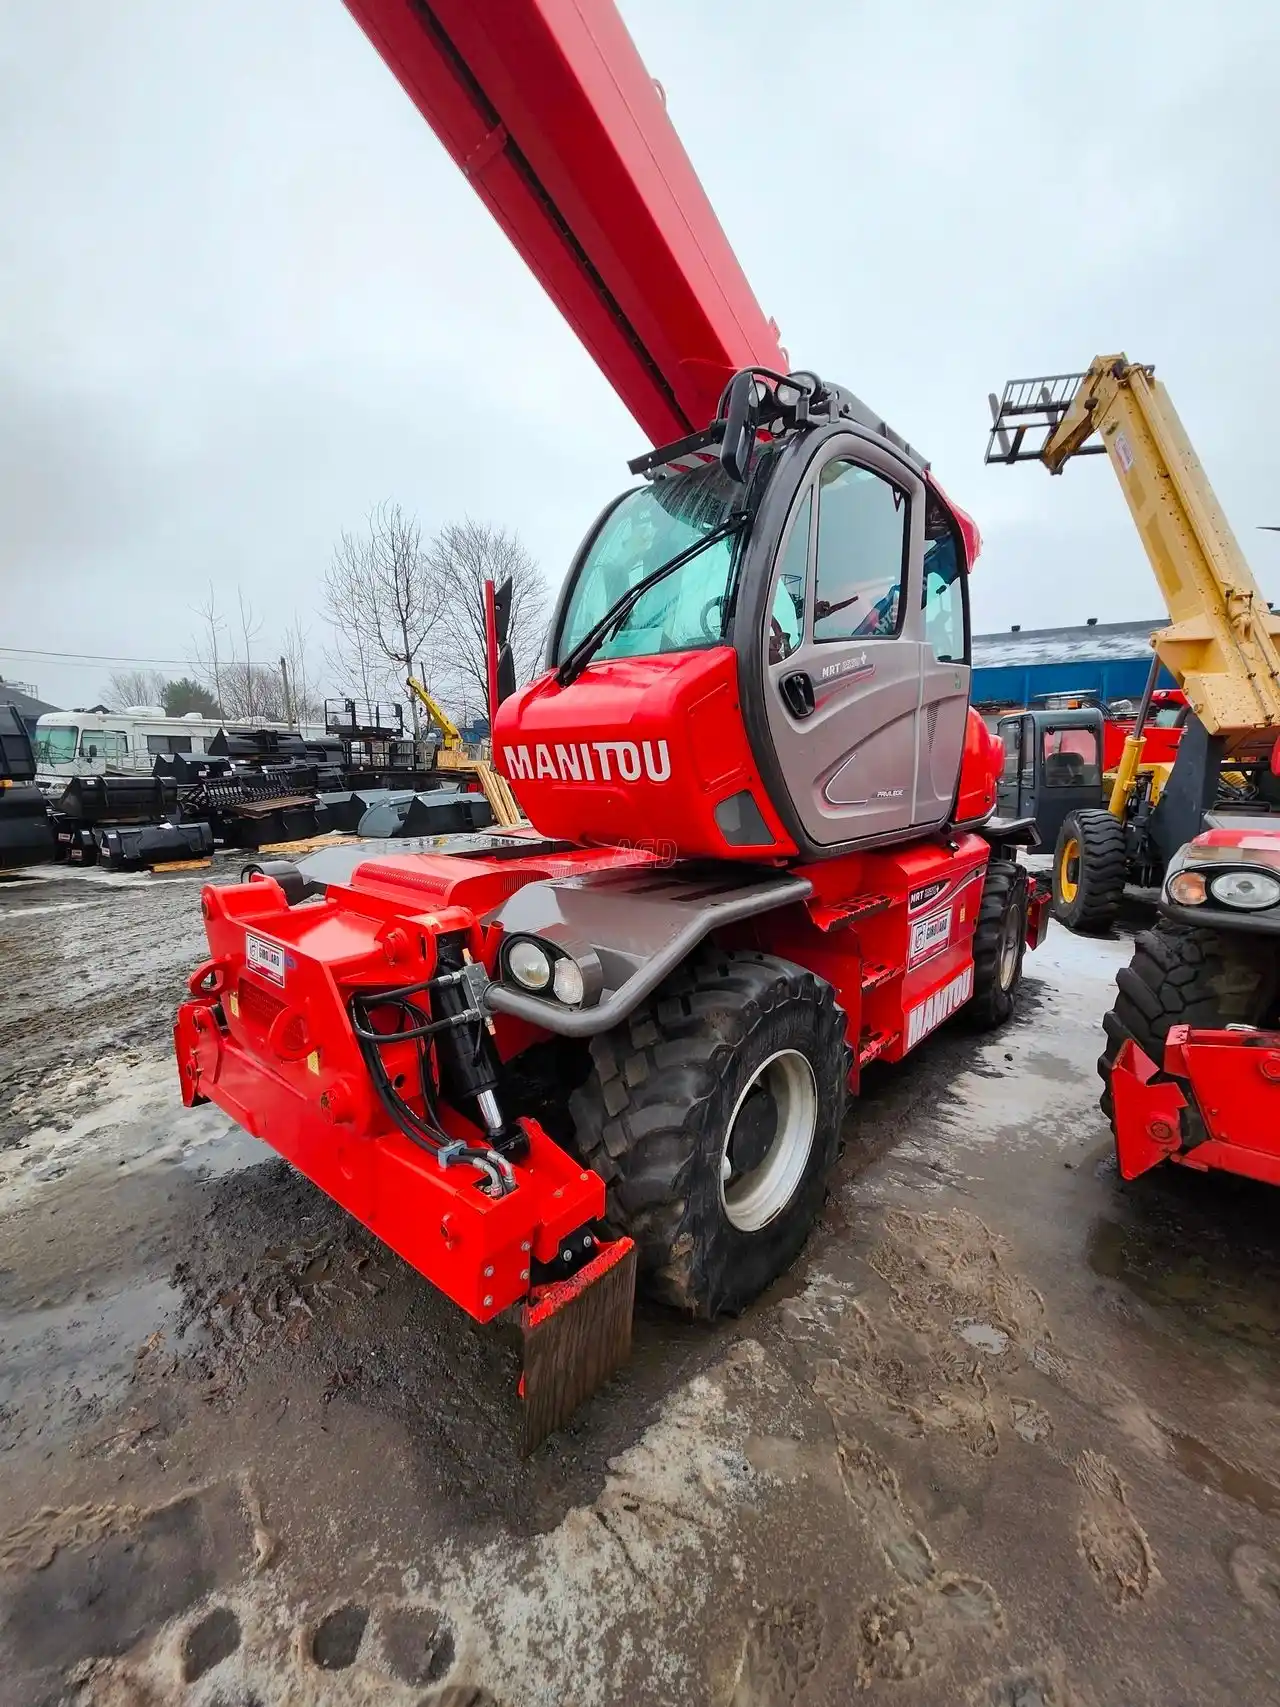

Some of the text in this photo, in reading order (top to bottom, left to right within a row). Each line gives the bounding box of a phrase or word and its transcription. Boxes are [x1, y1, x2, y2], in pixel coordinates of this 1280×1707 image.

[822, 662, 841, 678] MRT
[503, 740, 672, 782] MANITOU
[907, 967, 972, 1050] MANITOU
